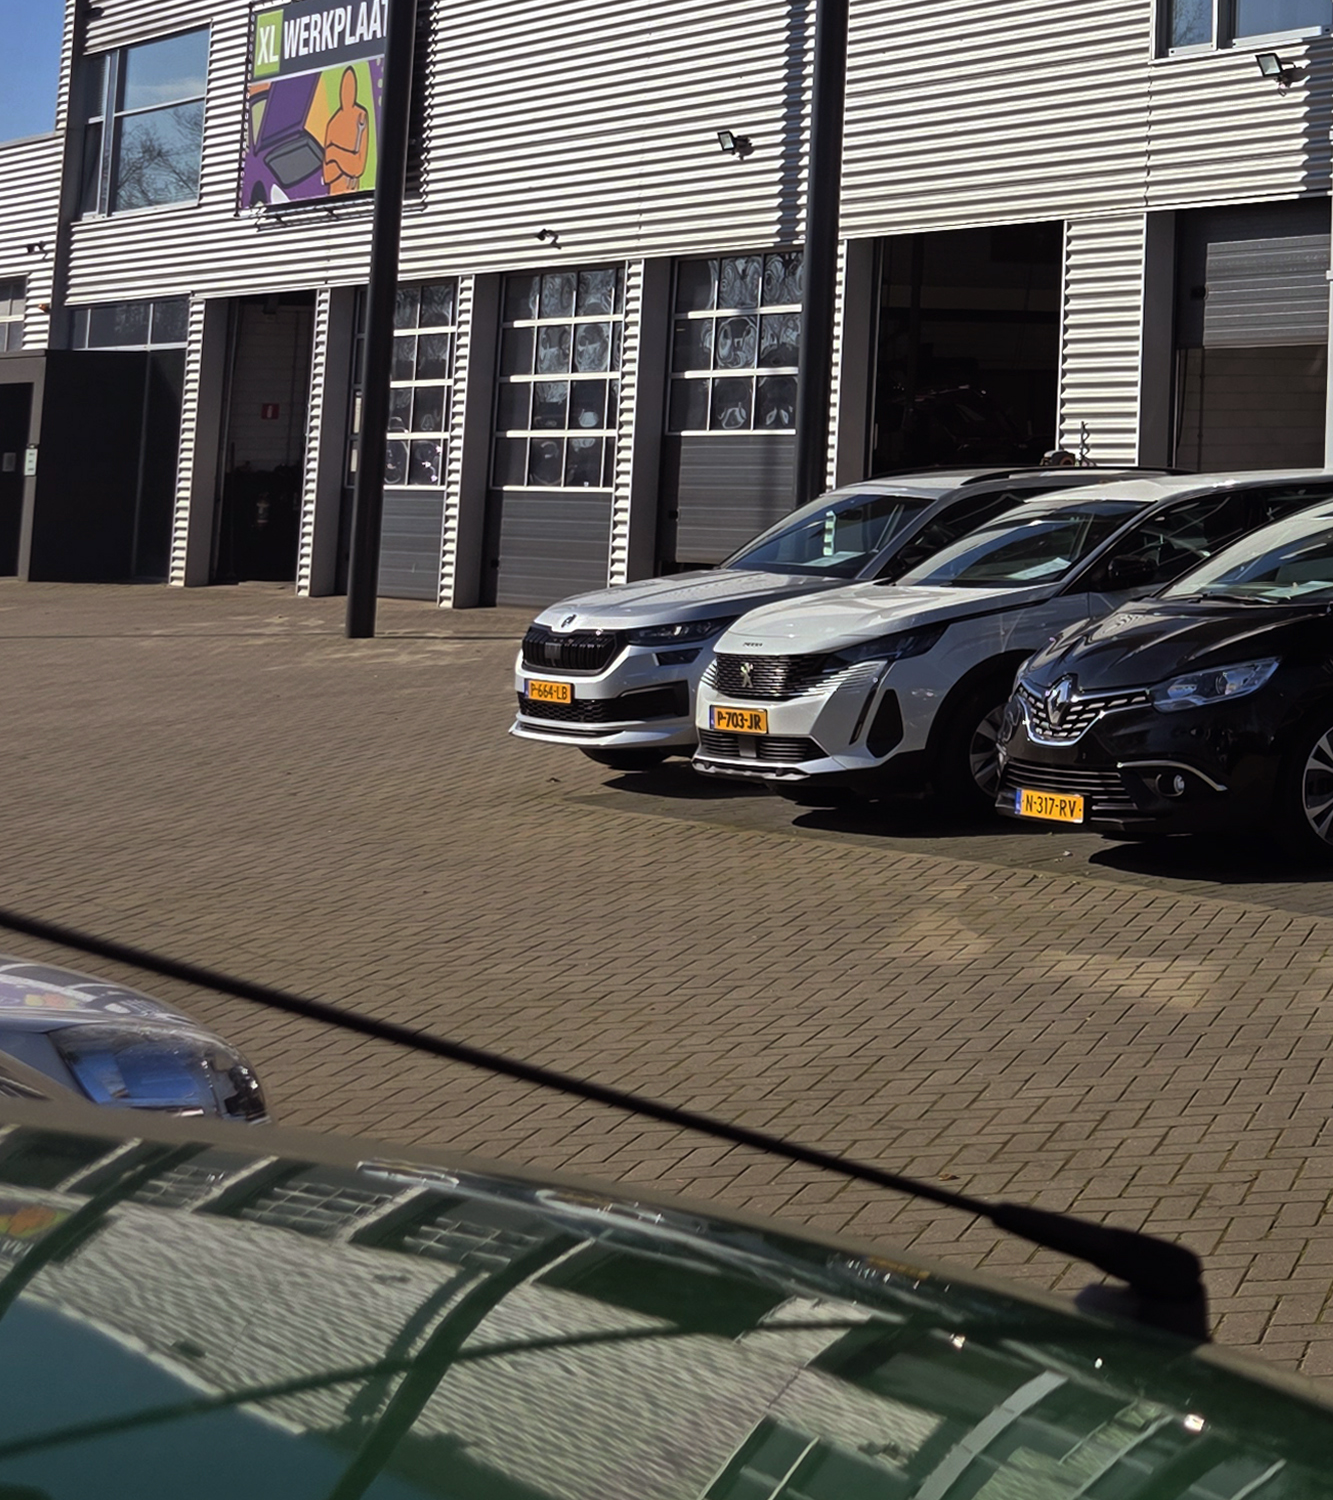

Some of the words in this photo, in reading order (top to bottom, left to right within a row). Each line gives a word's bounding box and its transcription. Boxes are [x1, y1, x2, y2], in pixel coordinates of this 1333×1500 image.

[257, 25, 279, 66] XL
[717, 710, 763, 731] P-703-JR
[1025, 794, 1077, 818] N-317-RV
